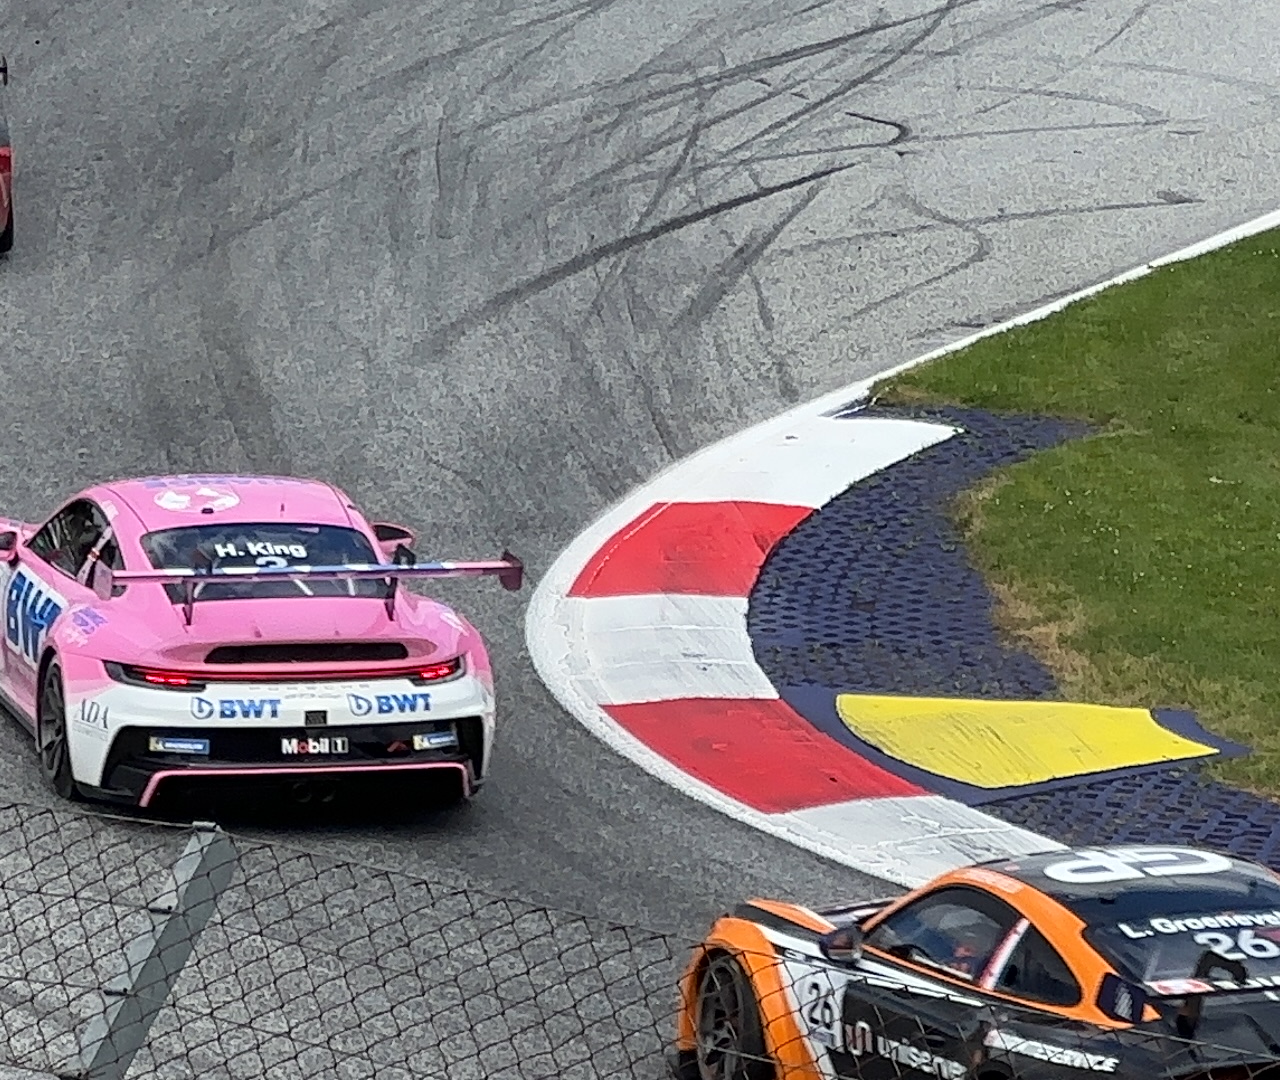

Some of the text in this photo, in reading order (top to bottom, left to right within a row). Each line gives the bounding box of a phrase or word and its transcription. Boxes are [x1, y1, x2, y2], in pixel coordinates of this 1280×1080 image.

[214, 542, 308, 559] H. King
[219, 698, 281, 720] BWT
[374, 692, 433, 715] BWT
[281, 738, 330, 754] Mobil
